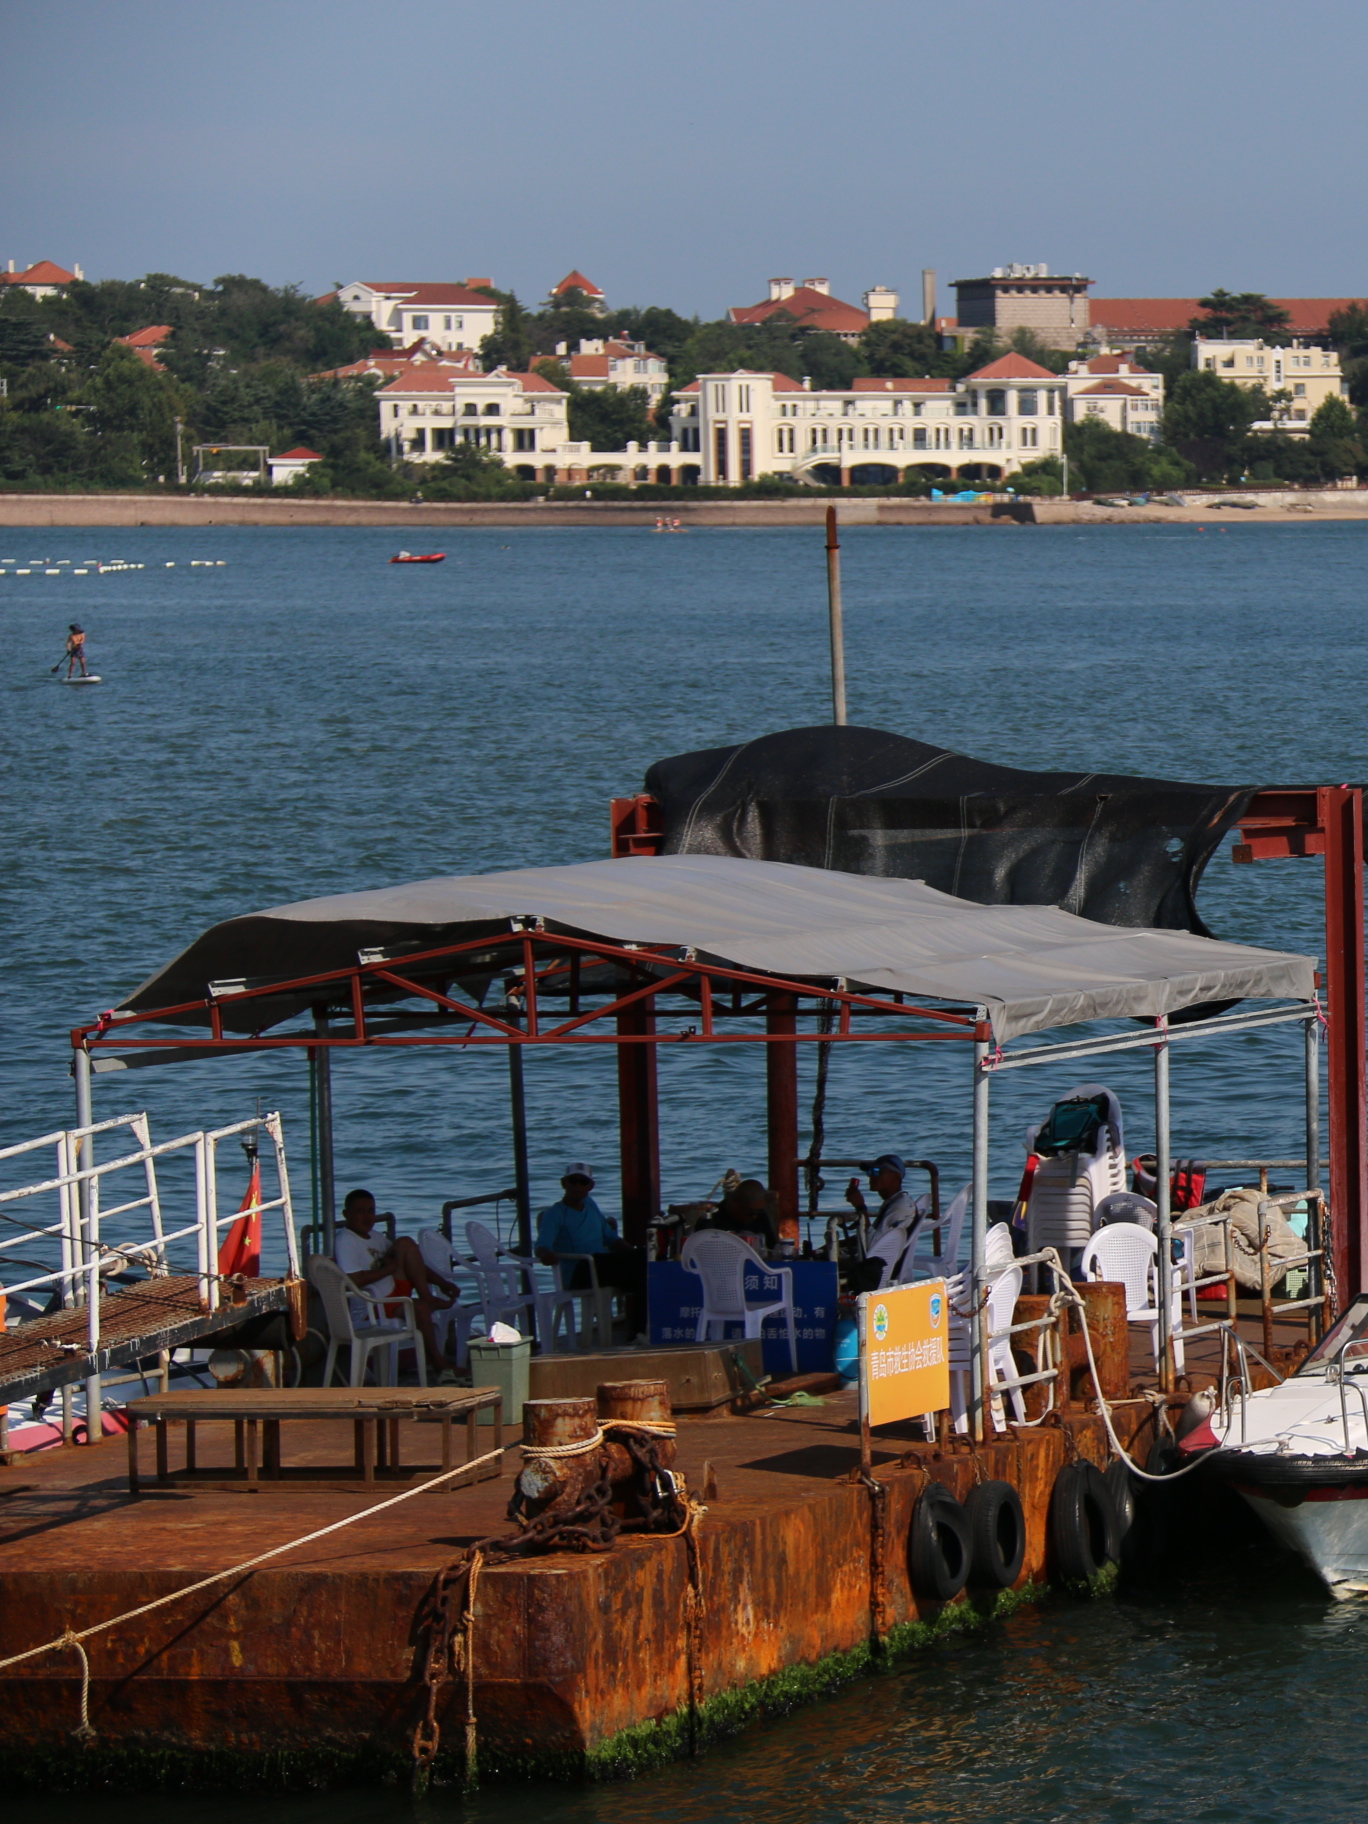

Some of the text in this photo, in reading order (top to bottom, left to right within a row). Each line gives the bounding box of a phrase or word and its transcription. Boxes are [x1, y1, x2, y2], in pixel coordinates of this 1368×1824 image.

[870, 1336, 945, 1380] 青岛市救生协会救援队
